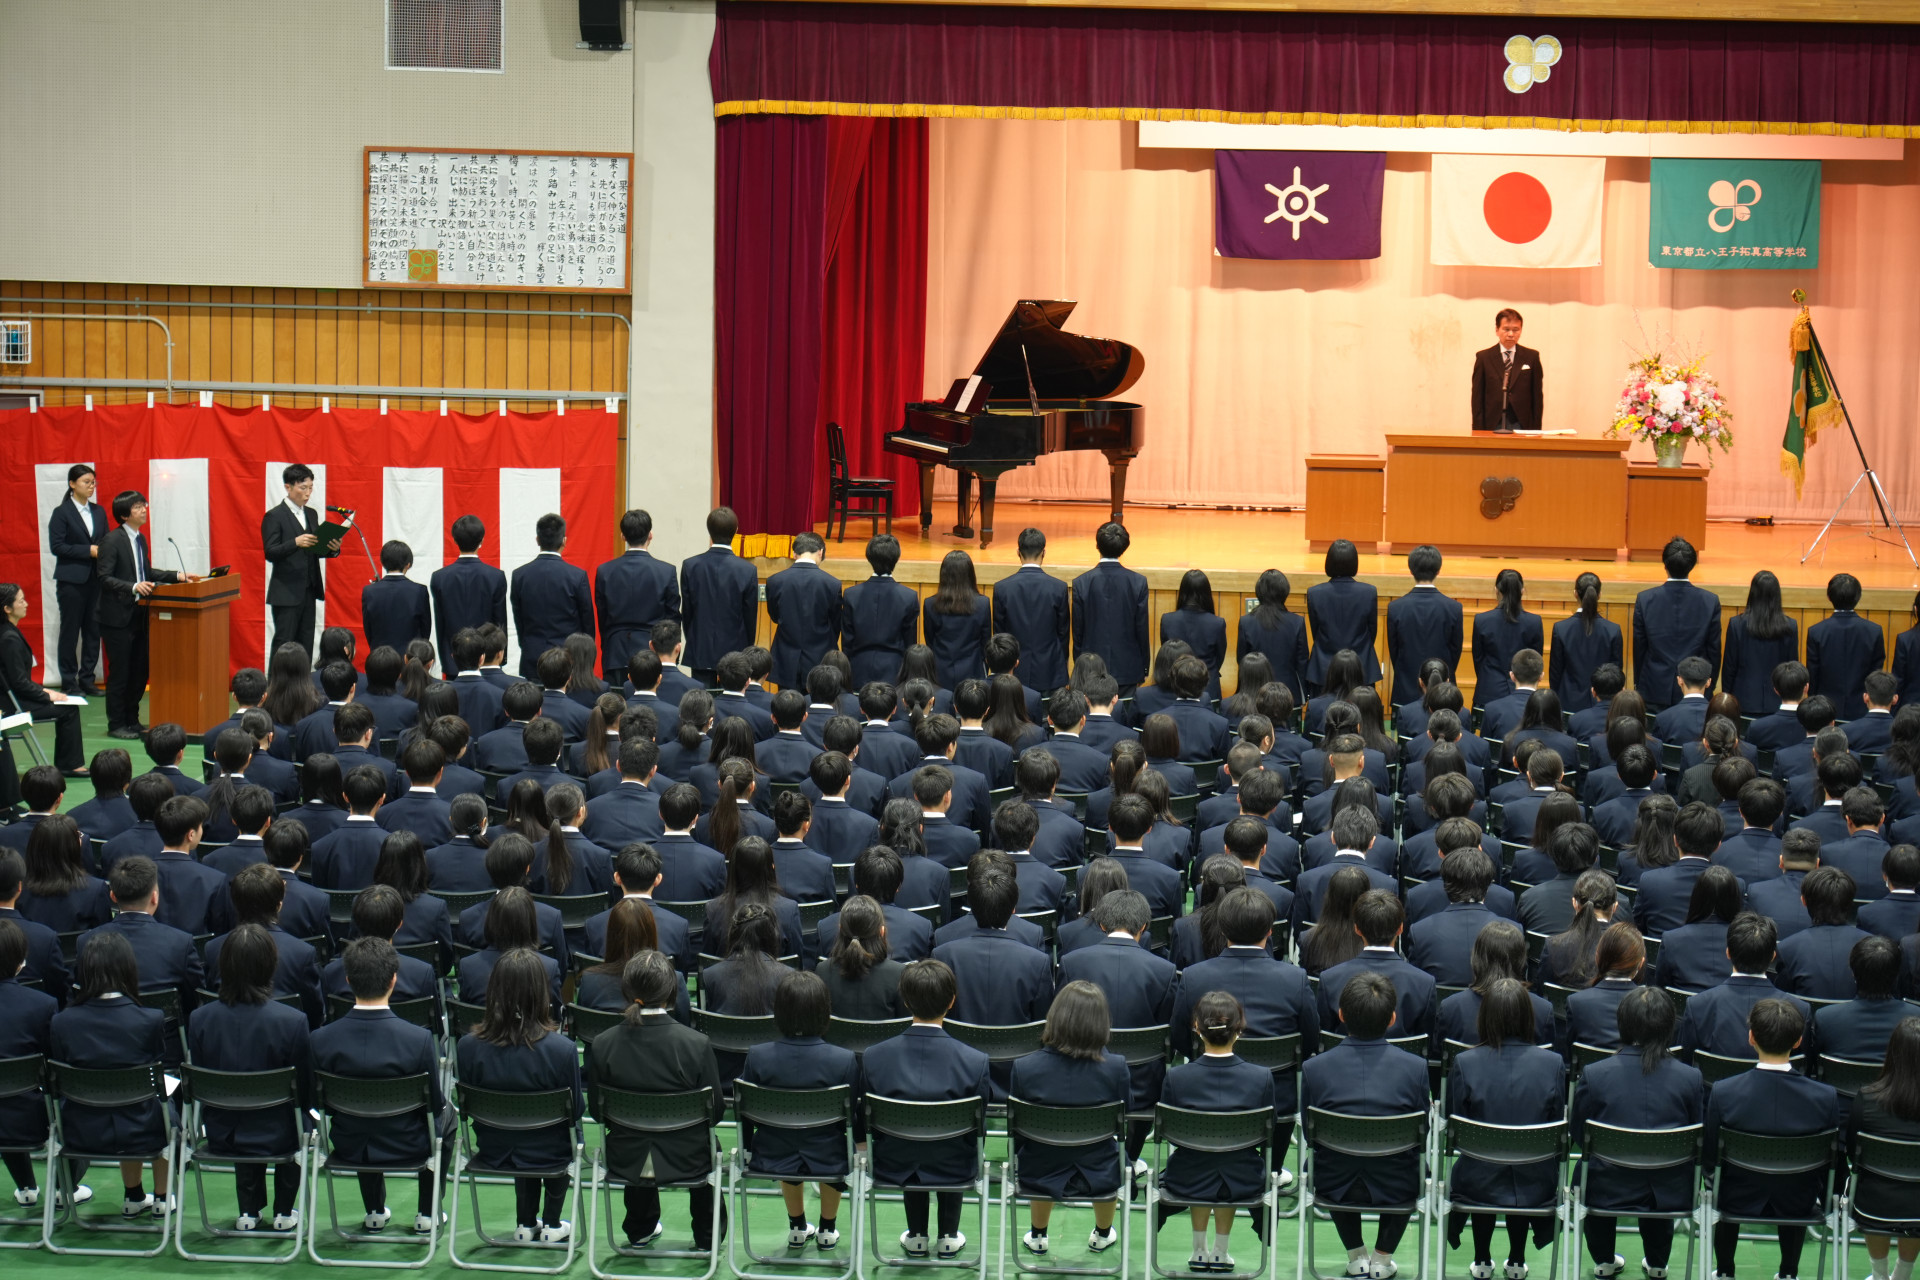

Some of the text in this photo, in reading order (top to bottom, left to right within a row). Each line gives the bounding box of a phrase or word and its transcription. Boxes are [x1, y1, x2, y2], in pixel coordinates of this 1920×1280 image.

[369, 163, 379, 270] 共に開こう明日の扉を
[379, 151, 389, 281] 共に探そうそれぞれの色を
[389, 163, 399, 270] 共に築こう笑顔の橋を
[399, 152, 409, 270] 共に描こう未来の地図を
[409, 174, 418, 250] この道を進もう
[418, 165, 429, 228] 励まし合って
[428, 152, 438, 229] 手を取り合って
[447, 156, 459, 271] 一人じゃ出来ないことも
[467, 154, 478, 272] 共に学ぼう新しい自分を
[476, 165, 488, 282] 共に笑おう泣いた分だけ
[486, 154, 498, 272] 共に歩もう果てなき道を
[507, 155, 519, 263] 悔しい時も苦しい時も
[528, 156, 538, 231] 涙は次への扉を
[547, 159, 558, 263] 一歩踏み出すその足に
[567, 157, 578, 265] 右手に消えない勇気を
[586, 158, 599, 254] 答えよりも歩む道の
[606, 158, 618, 275] 果てなく伸びるこの道の
[618, 180, 628, 234] 果てなき道
[438, 218, 447, 271] 沢山あるさ
[496, 198, 506, 283] その心は消えない
[517, 198, 528, 284] 開くためのカギさ
[536, 242, 546, 284] 輝く希望
[557, 199, 567, 285] 左手に強い誇りを
[577, 222, 586, 286] 意味を探そう
[1661, 245, 1807, 257] 東京都立八王子拓真高等学校
